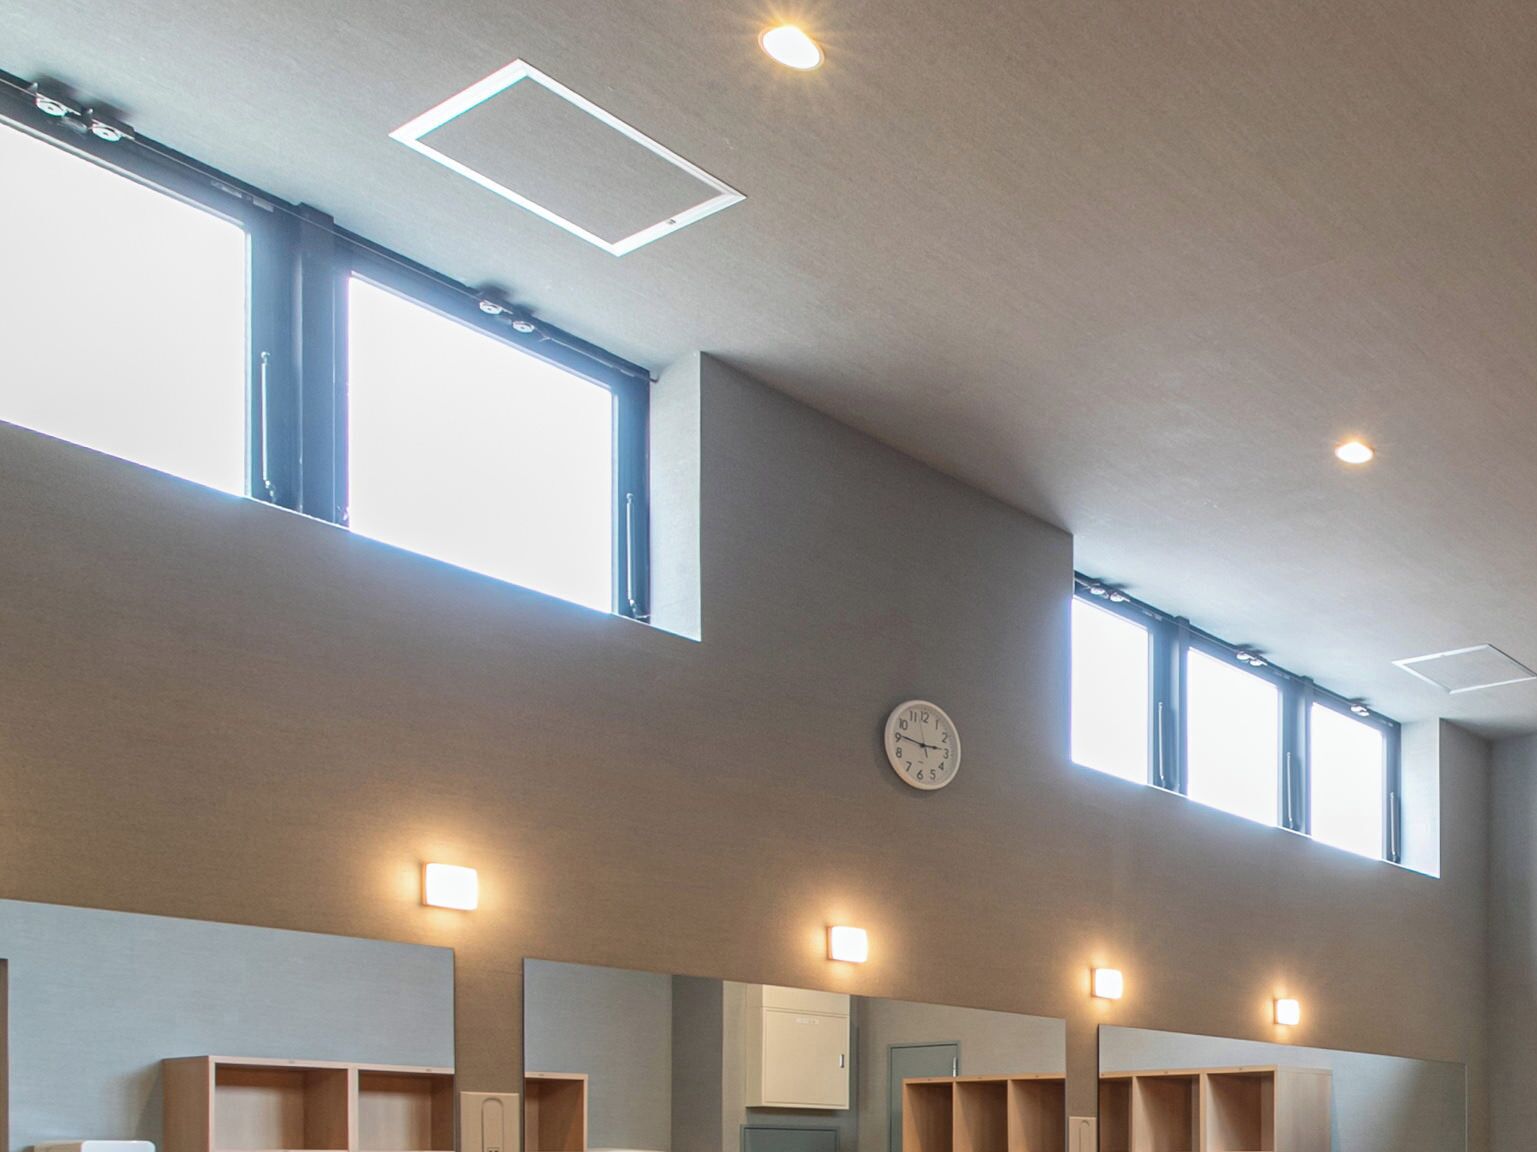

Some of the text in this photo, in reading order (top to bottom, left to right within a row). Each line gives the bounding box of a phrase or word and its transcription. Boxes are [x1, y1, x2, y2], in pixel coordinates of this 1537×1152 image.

[909, 711, 918, 723] 11
[920, 711, 930, 724] 12
[899, 718, 909, 731] 10
[935, 719, 939, 730] 1
[894, 732, 902, 743] 9
[941, 732, 949, 744] 2
[895, 747, 903, 759] 8
[943, 748, 950, 760] 3
[905, 761, 913, 772] 7
[938, 761, 945, 771] 4
[916, 769, 924, 780] 6
[929, 769, 937, 780] 5
